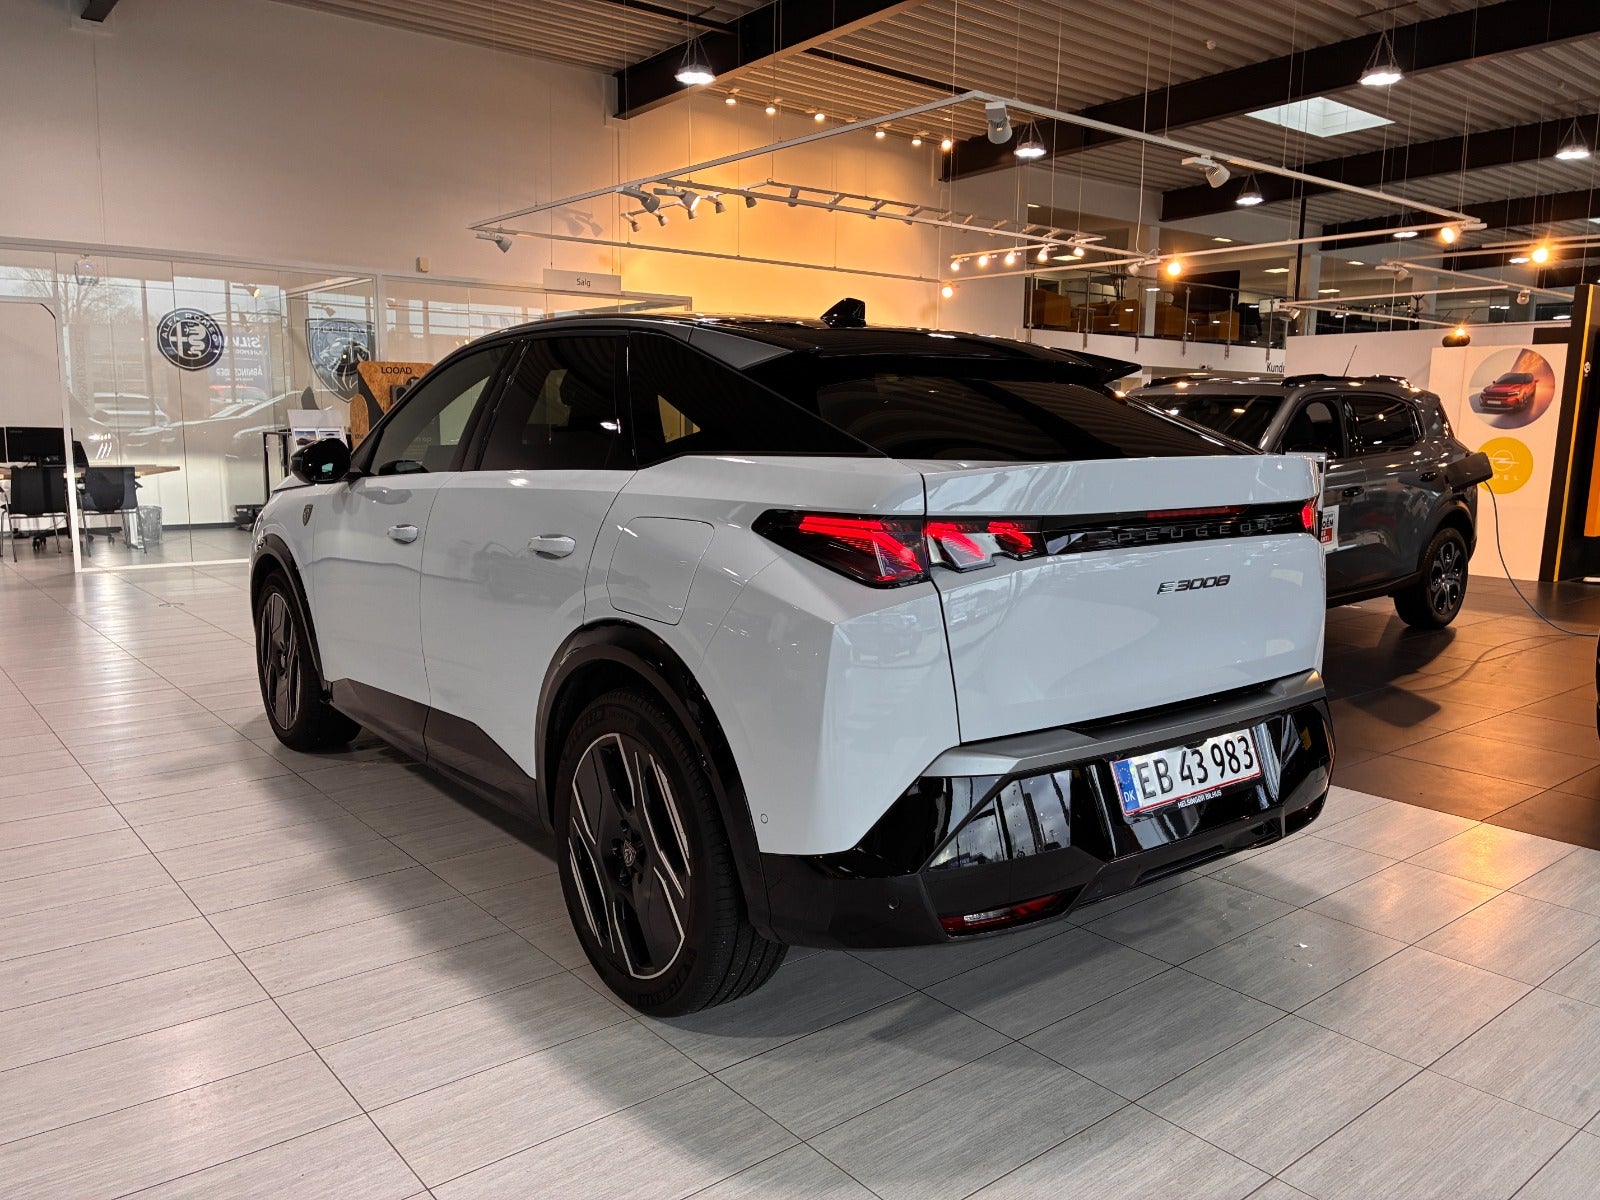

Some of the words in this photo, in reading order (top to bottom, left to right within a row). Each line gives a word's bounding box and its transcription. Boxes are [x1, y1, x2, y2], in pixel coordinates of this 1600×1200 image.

[576, 278, 591, 287] Salg
[161, 316, 181, 339] ALFA
[185, 312, 218, 342] ROMEO
[381, 366, 413, 375] LOOAD
[1117, 521, 1271, 544] PEUGEOT
[1135, 757, 1174, 800] EB
[1179, 748, 1209, 786] 43
[1210, 735, 1254, 779] 983
[1123, 790, 1136, 803] DK
